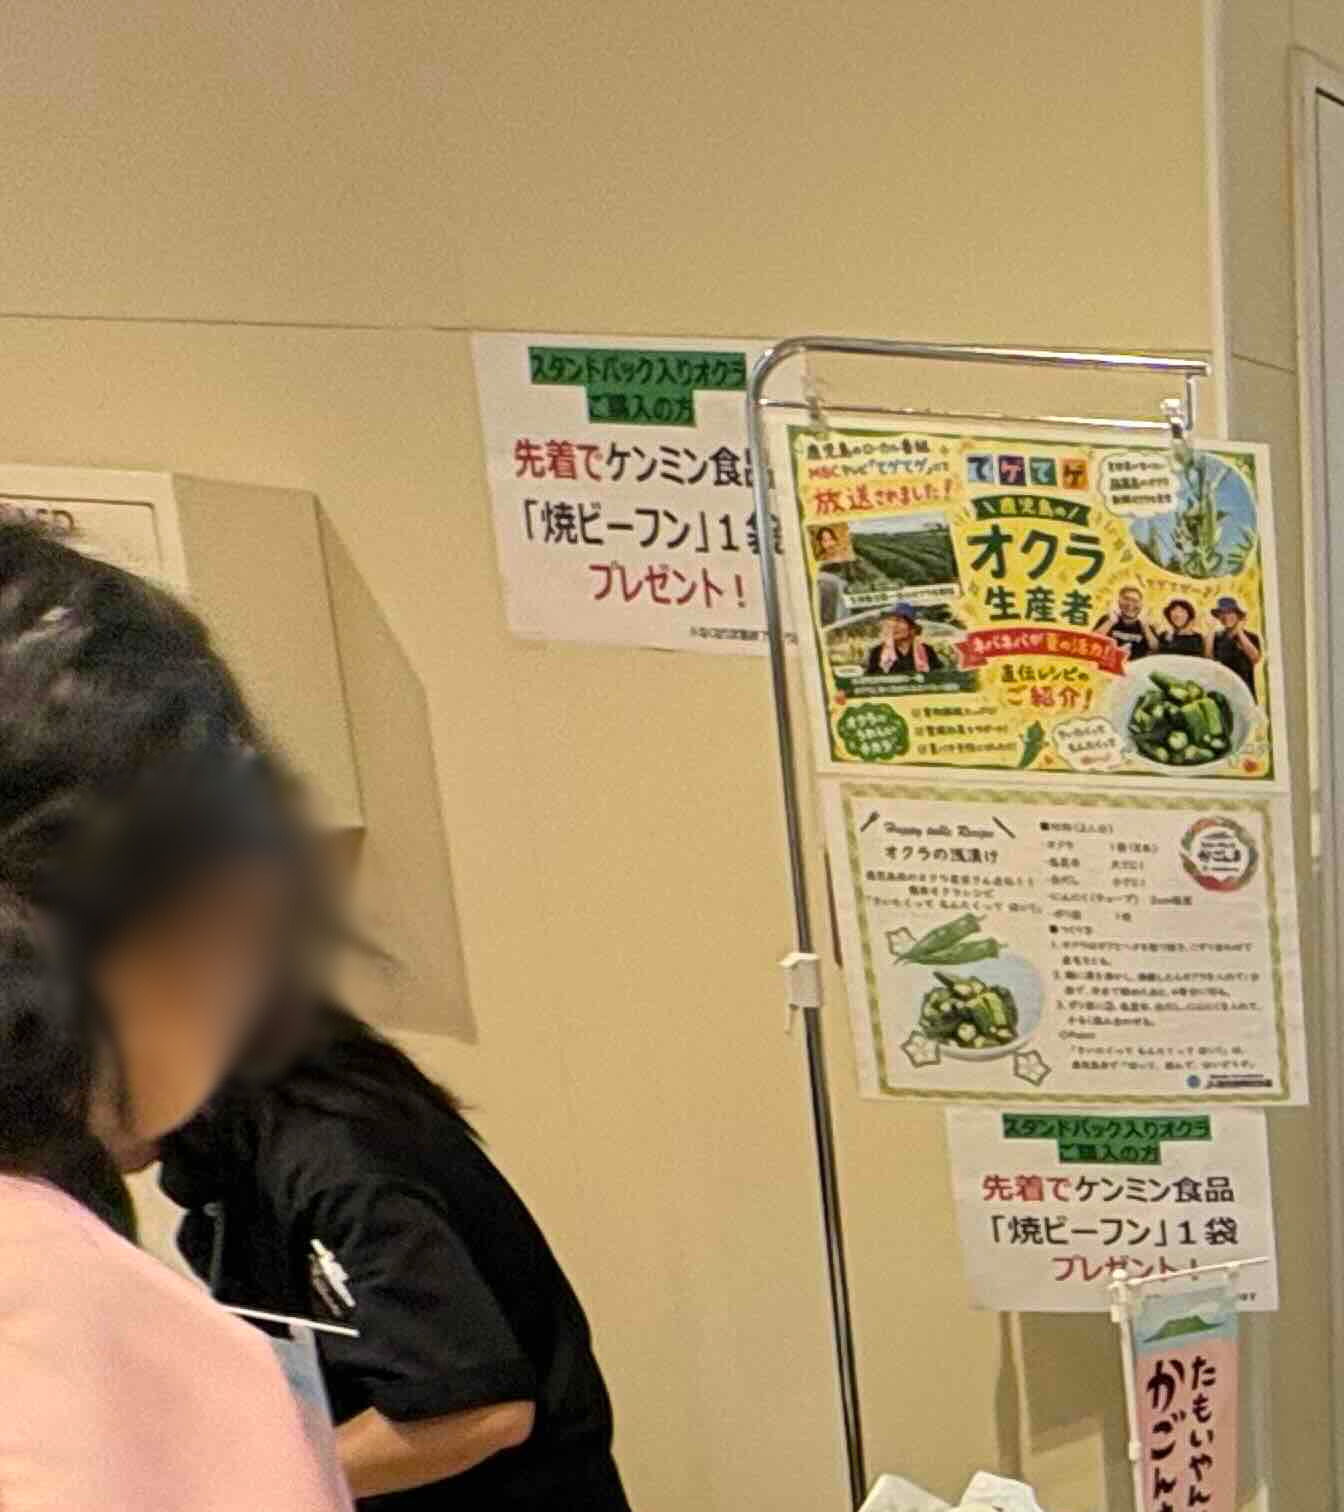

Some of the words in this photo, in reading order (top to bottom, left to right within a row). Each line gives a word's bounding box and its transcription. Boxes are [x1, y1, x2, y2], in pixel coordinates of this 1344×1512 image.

[531, 353, 746, 387] スタンドパック入りオクラ
[589, 393, 695, 425] ご購入の方
[967, 523, 1106, 584] オクラ
[589, 561, 747, 608] プレゼント！
[984, 585, 1093, 626] 生産者
[1001, 663, 1090, 683] 直伝レシピの
[1007, 685, 1093, 710] ご紹介!
[1004, 1115, 1211, 1140] スタンドパック入りオクラ
[1059, 1142, 1161, 1164] ご購入の方
[982, 1174, 1235, 1203] 先着でケンミン食品
[990, 1216, 1239, 1247] 「焼ビーフン」1袋
